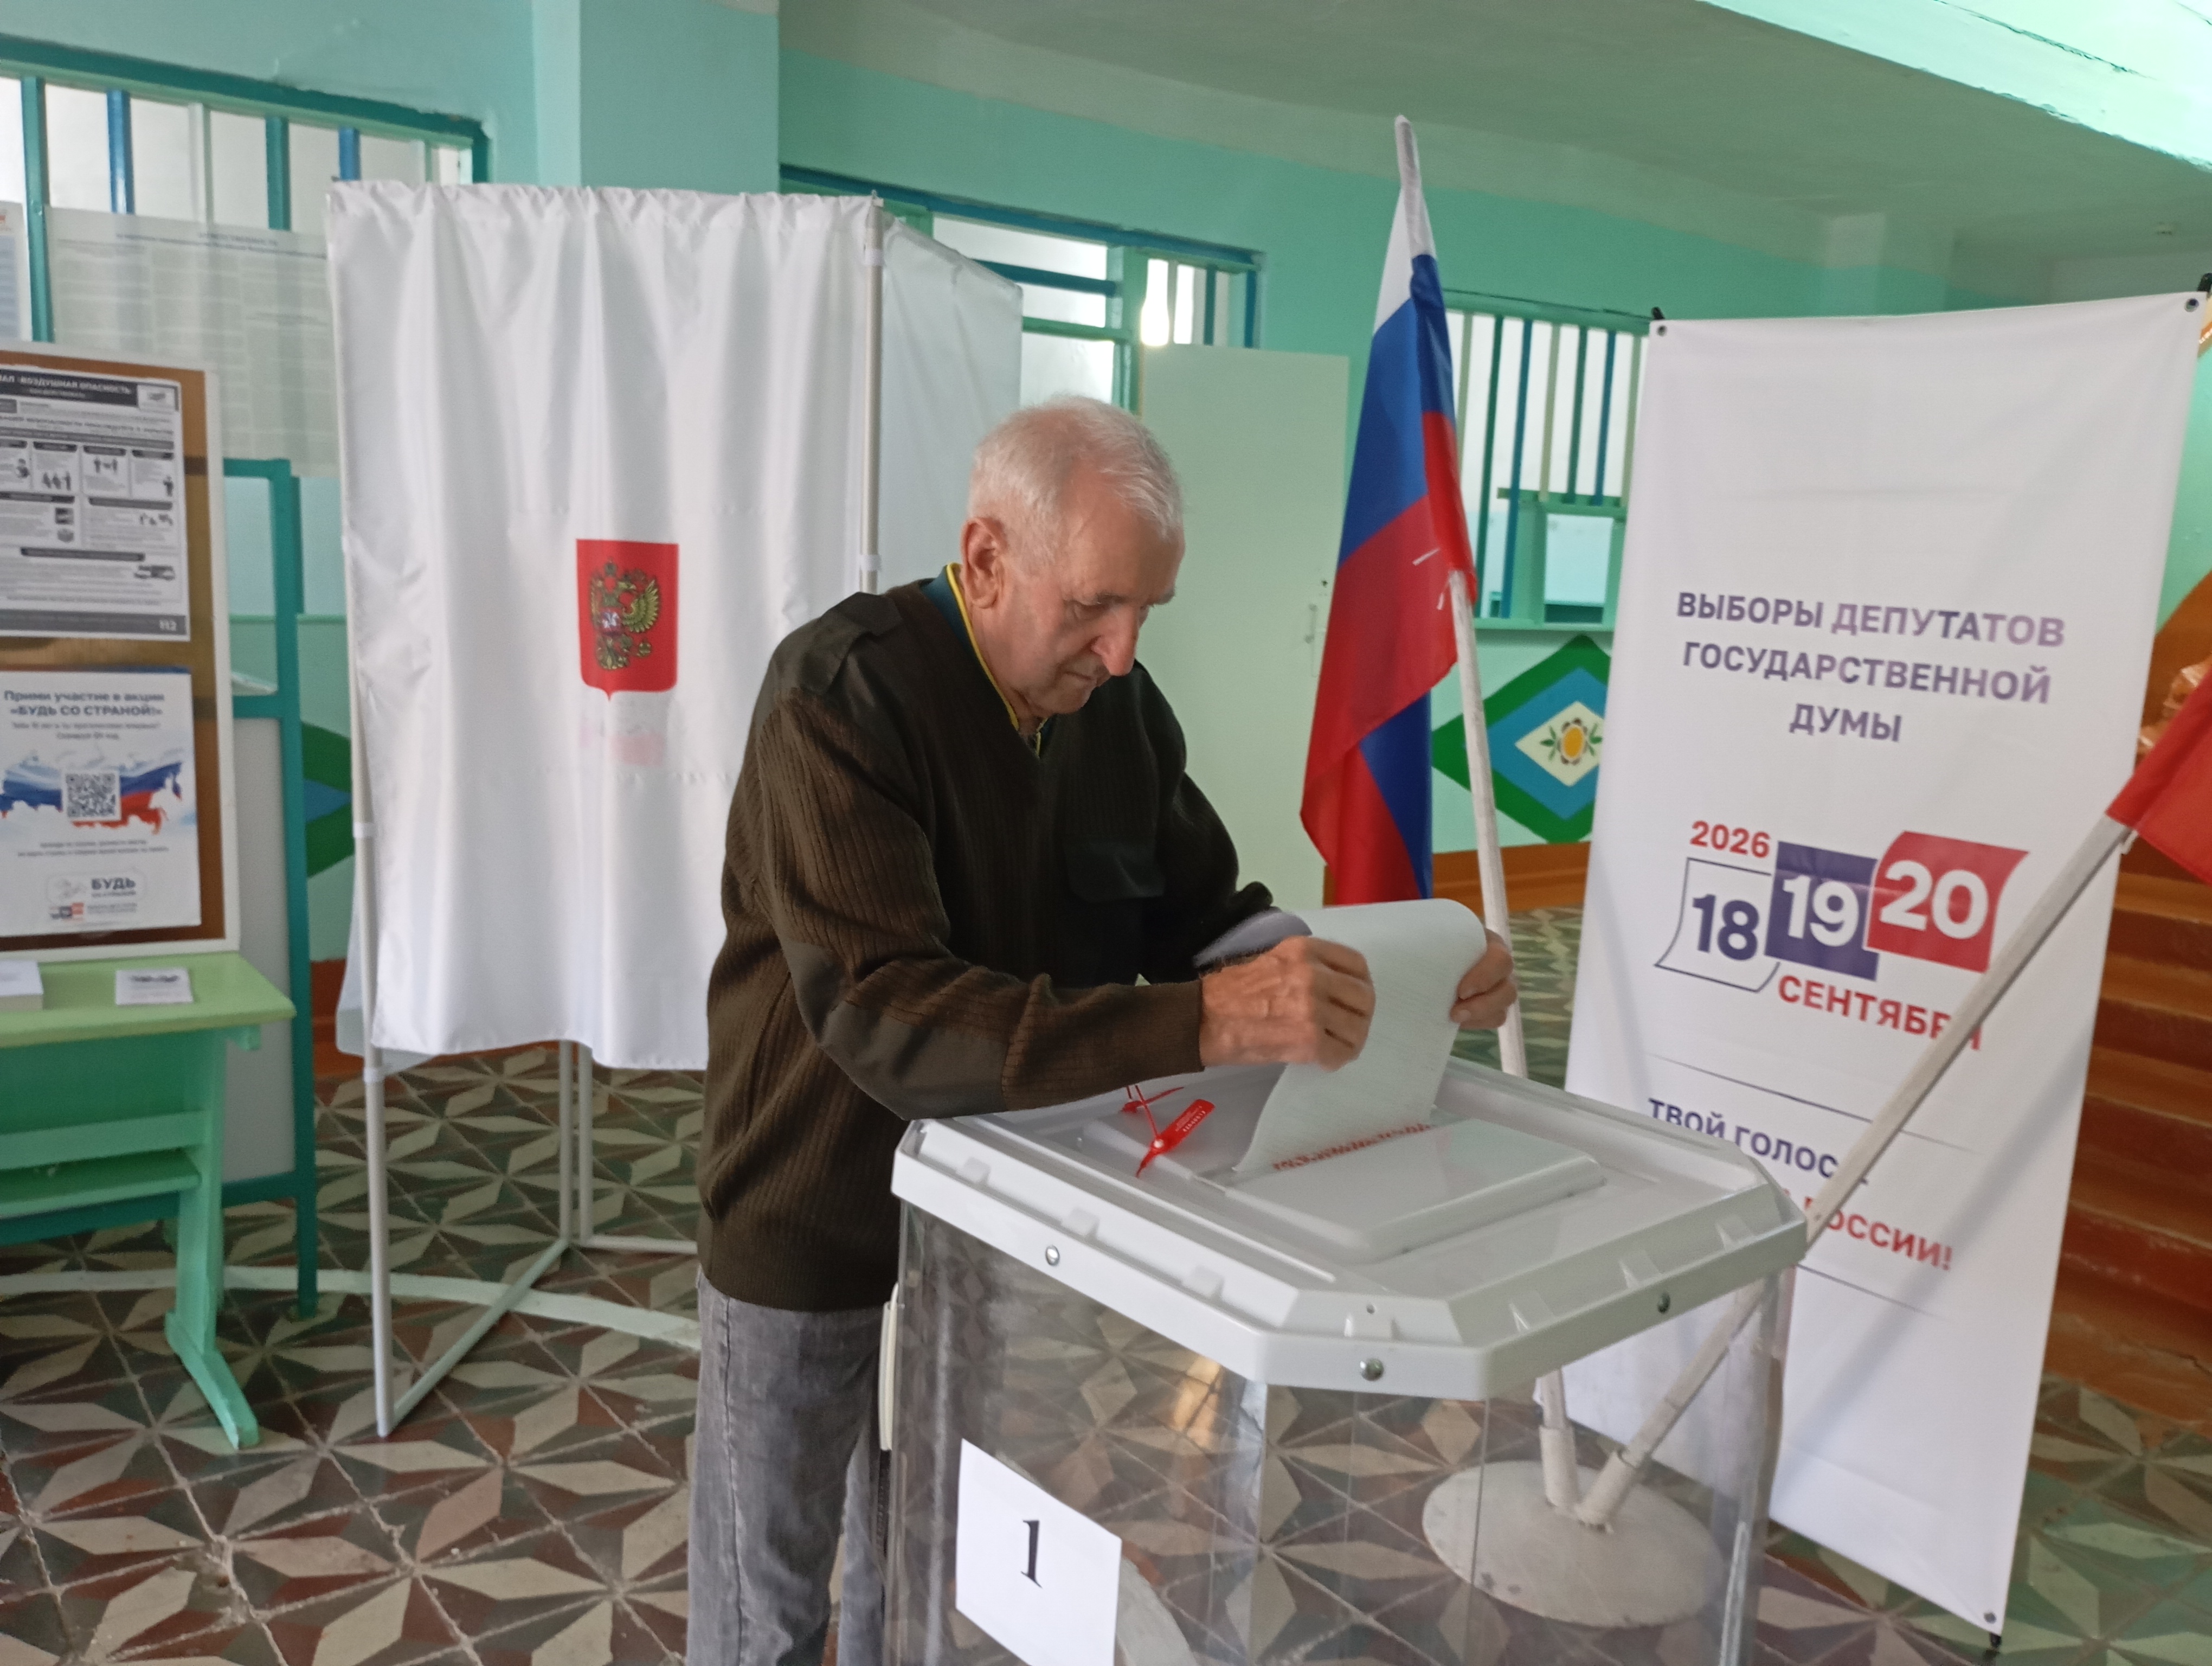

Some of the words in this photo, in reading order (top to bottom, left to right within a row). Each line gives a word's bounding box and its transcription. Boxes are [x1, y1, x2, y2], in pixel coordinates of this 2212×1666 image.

[1676, 592, 1823, 629] ВЫБОРЫ
[1831, 603, 2066, 648] ДЕПУТАТОВ
[1682, 642, 2051, 704] ГОСУДАРСТВЕННОЙ
[60, 706, 81, 716] СО
[1789, 703, 1902, 742] ДУМЫ
[1689, 820, 1771, 858] 2026
[91, 877, 136, 890] БУДЬ
[1692, 894, 1760, 961] 18
[1783, 874, 1860, 947] 19
[1879, 860, 1989, 940] 20
[1648, 1098, 1725, 1138] ТВОЙ
[1735, 1125, 1838, 1178] ГОЛОС
[1804, 1196, 1952, 1271] ОССИИ!
[1020, 1520, 1043, 1589] 1
